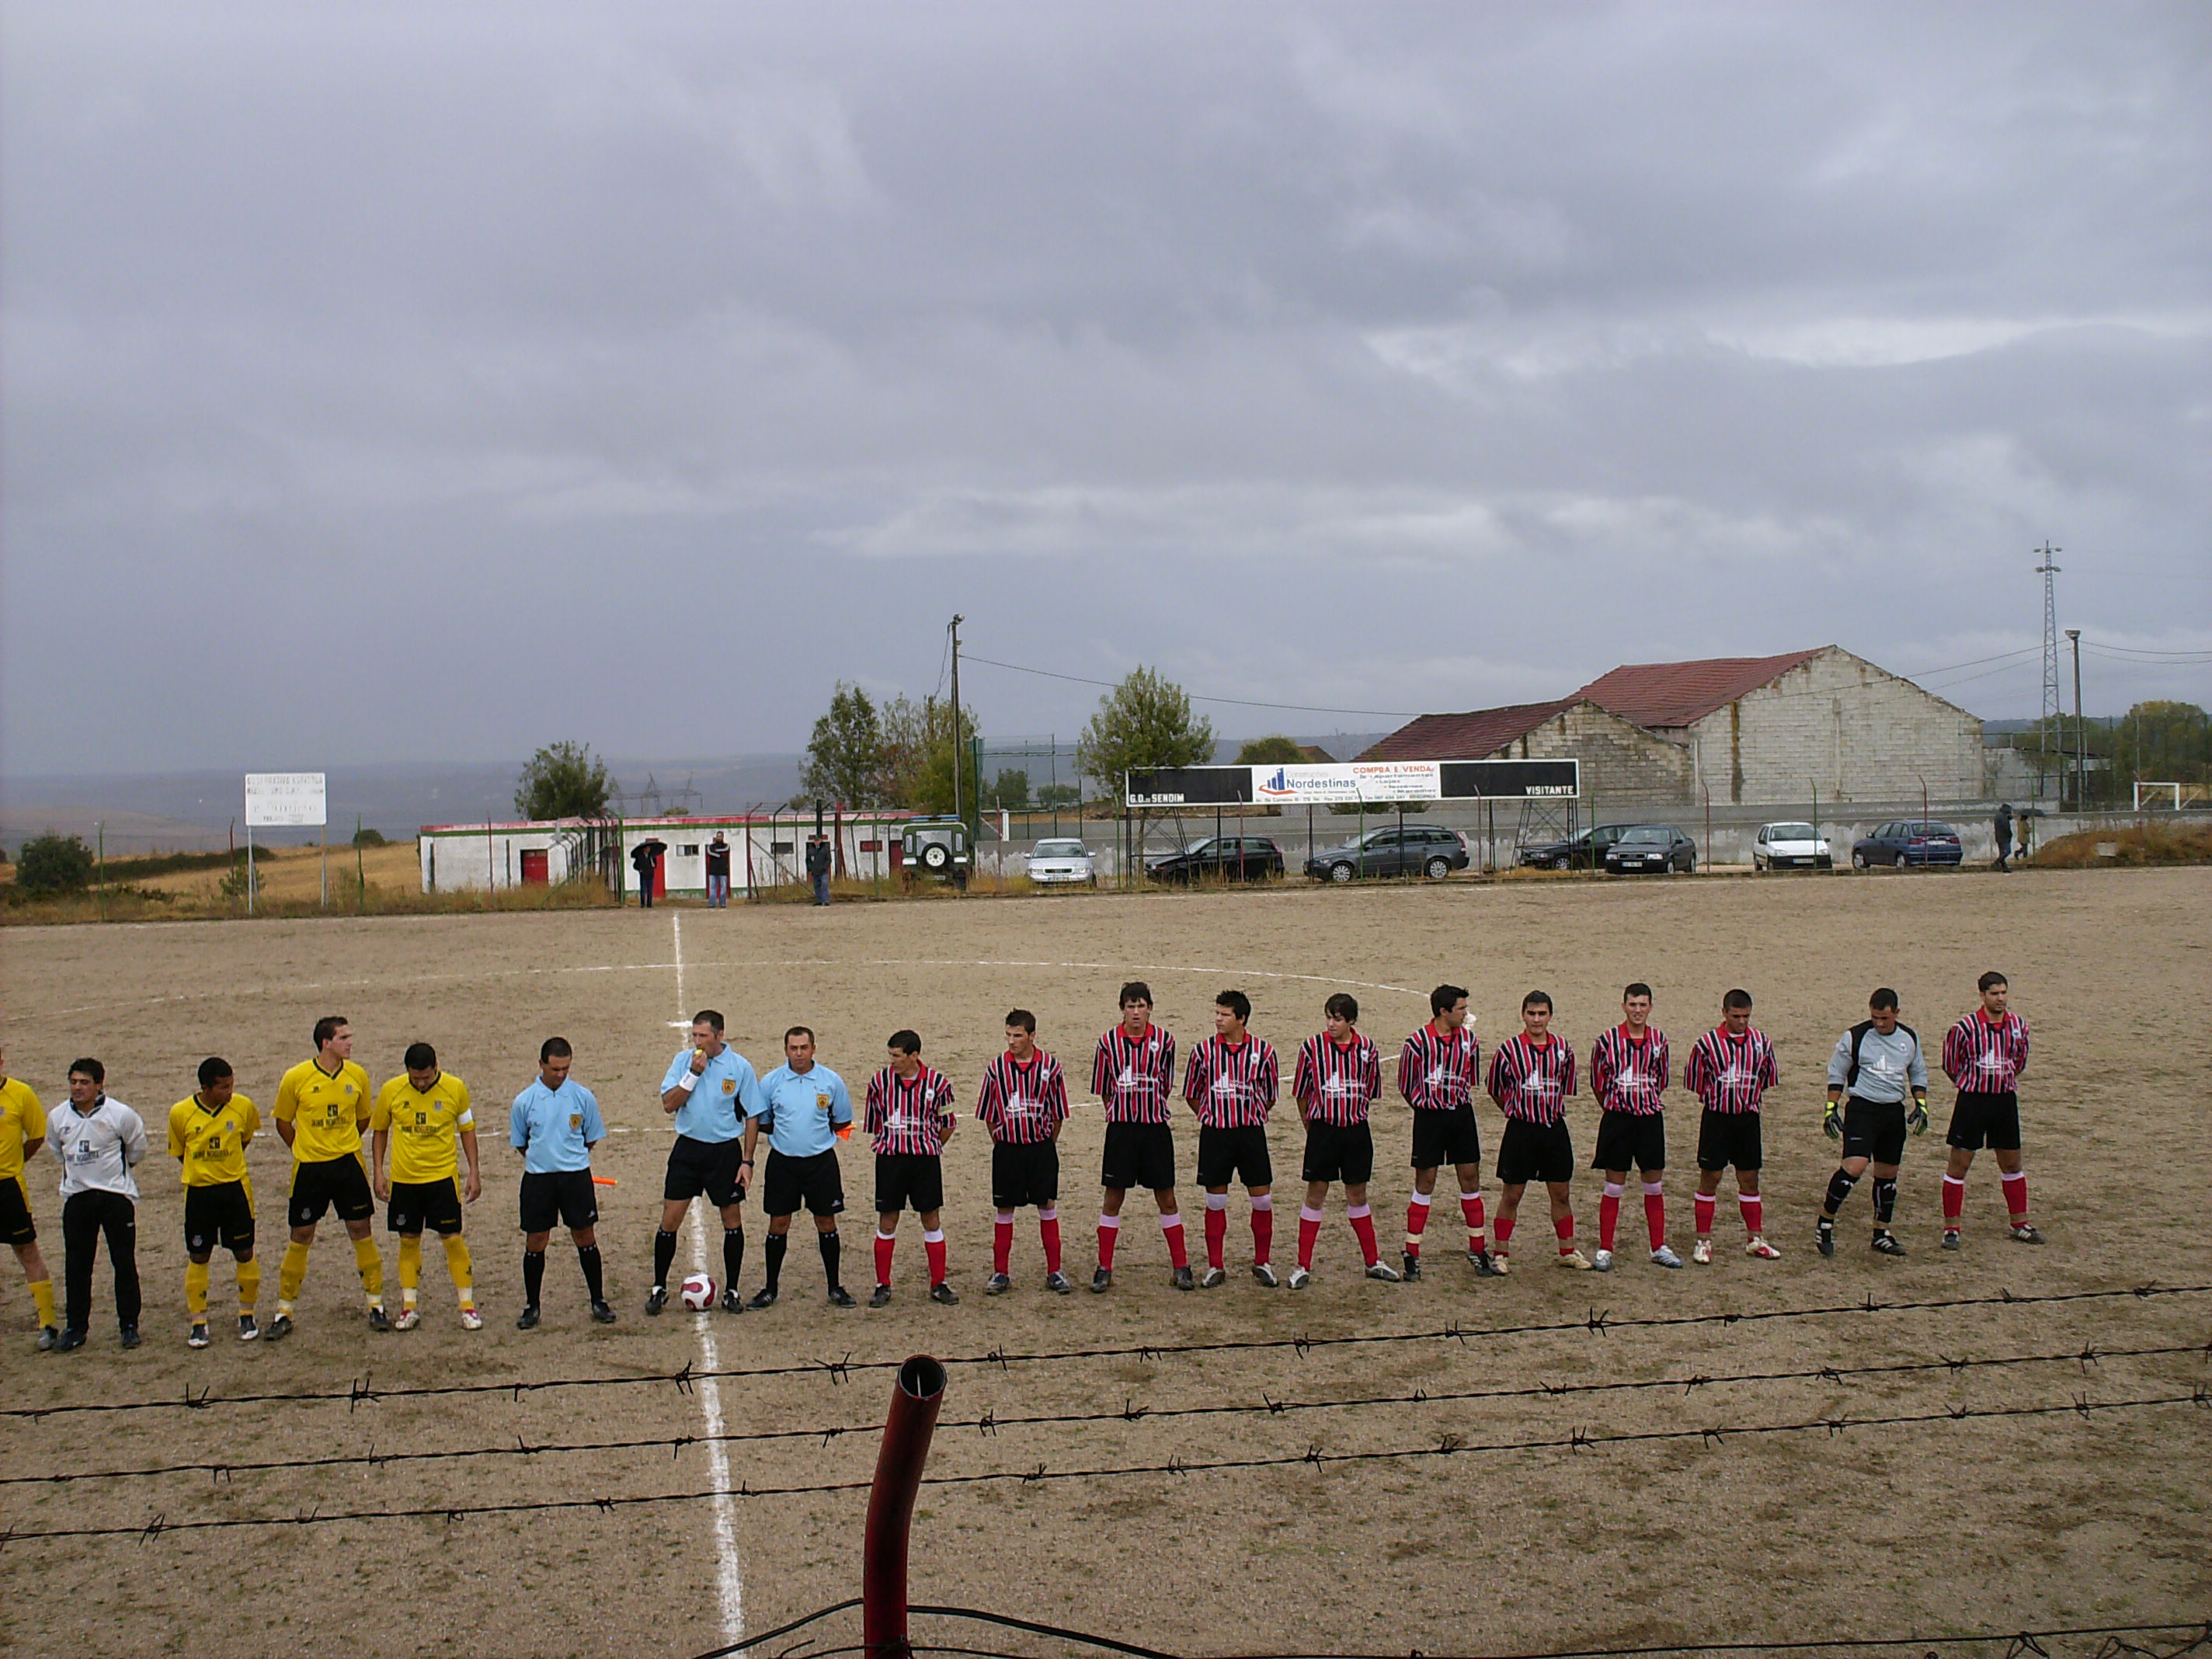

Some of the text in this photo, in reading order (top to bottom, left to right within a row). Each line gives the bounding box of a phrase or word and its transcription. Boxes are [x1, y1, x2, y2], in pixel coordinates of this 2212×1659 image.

[1287, 777, 1356, 789] Nordestinas
[1525, 785, 1574, 795] VISITANTE
[1151, 793, 1184, 802] SENDIM
